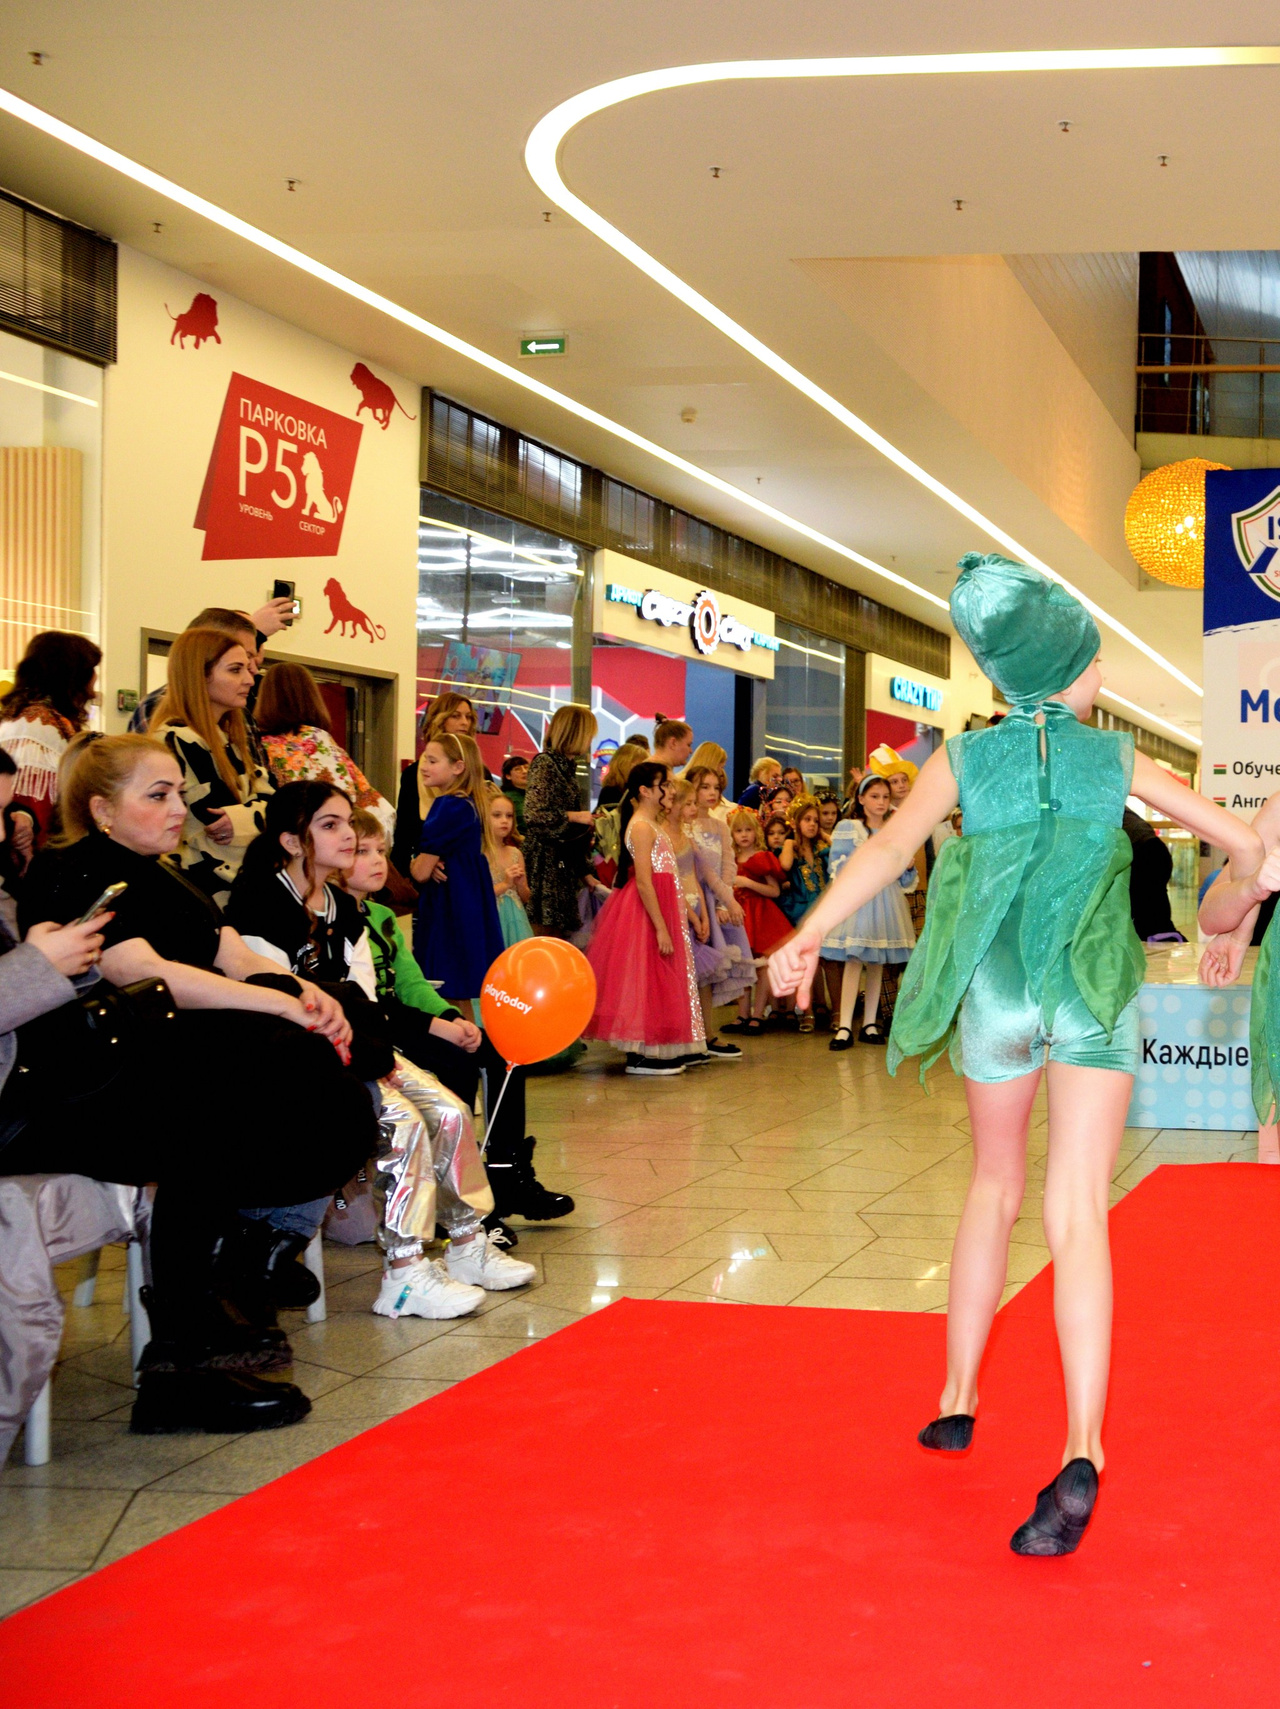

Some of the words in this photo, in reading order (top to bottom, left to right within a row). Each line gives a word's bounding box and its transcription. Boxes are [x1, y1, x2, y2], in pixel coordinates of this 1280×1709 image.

[240, 397, 327, 450] ПАРКОВКА
[238, 502, 274, 522] УРОВЕНЬ
[299, 520, 326, 536] СЕКТОР
[891, 676, 924, 708] CRAZY
[484, 983, 533, 1015] playToday
[1142, 1038, 1249, 1070] Каждые
